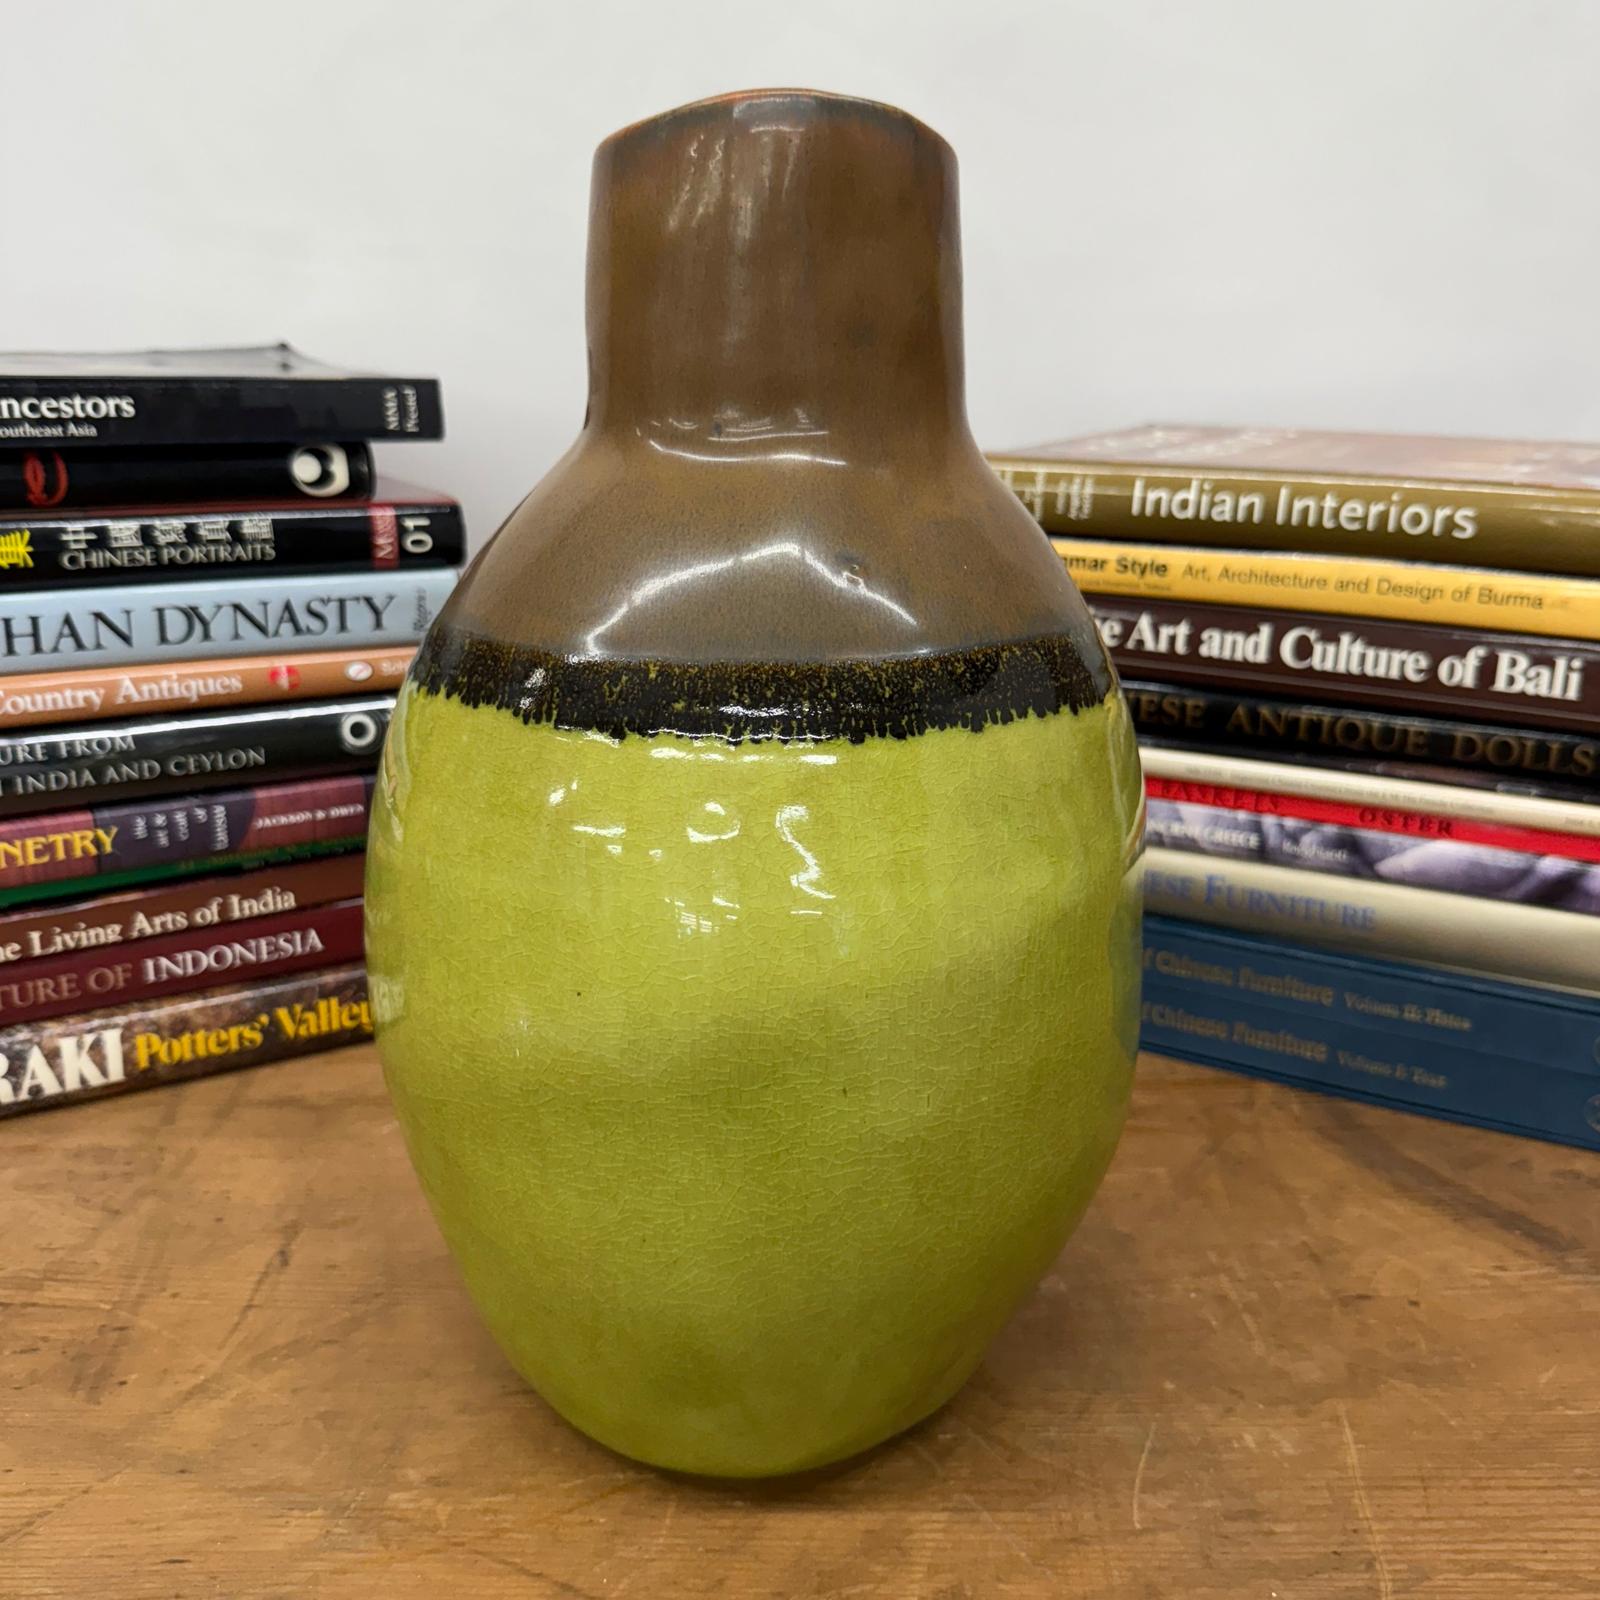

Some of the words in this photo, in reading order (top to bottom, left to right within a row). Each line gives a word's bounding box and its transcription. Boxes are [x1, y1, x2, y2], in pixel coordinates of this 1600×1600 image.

[67, 421, 98, 437] Asia
[1131, 477, 1264, 525] Indian
[1276, 485, 1479, 540] Interiors
[60, 549, 157, 570] CHINESE
[159, 543, 276, 565] PORTRAITS
[401, 516, 433, 553] 01
[1115, 557, 1168, 578] Style
[1182, 564, 1211, 582] Art,
[1218, 566, 1328, 591] Architecture
[1333, 575, 1369, 594] and
[1375, 578, 1444, 603] Design
[1451, 584, 1475, 603] of
[1477, 587, 1544, 610] Burma
[1, 609, 133, 656] HAN
[154, 594, 397, 646] DYNASTY
[1125, 611, 1193, 655] Art
[1199, 624, 1268, 665] and
[1279, 626, 1428, 684] Culture
[1437, 643, 1482, 688] of
[1492, 648, 1584, 702] Bali
[116, 672, 243, 703] Antiques
[60, 735, 136, 757] FROM
[1227, 703, 1429, 754] ANTIQUE
[1452, 731, 1597, 776] DOLLS
[15, 765, 96, 795] INDIA
[102, 760, 161, 784] AND
[166, 747, 265, 775] CEYLON
[1358, 808, 1453, 836] OSTER
[0, 826, 118, 869] NETRY
[27, 924, 122, 957] Living
[129, 910, 189, 939] Arts
[190, 897, 223, 926] of
[229, 887, 296, 917] India
[88, 963, 133, 992] OF
[142, 928, 325, 984] INDONESIA
